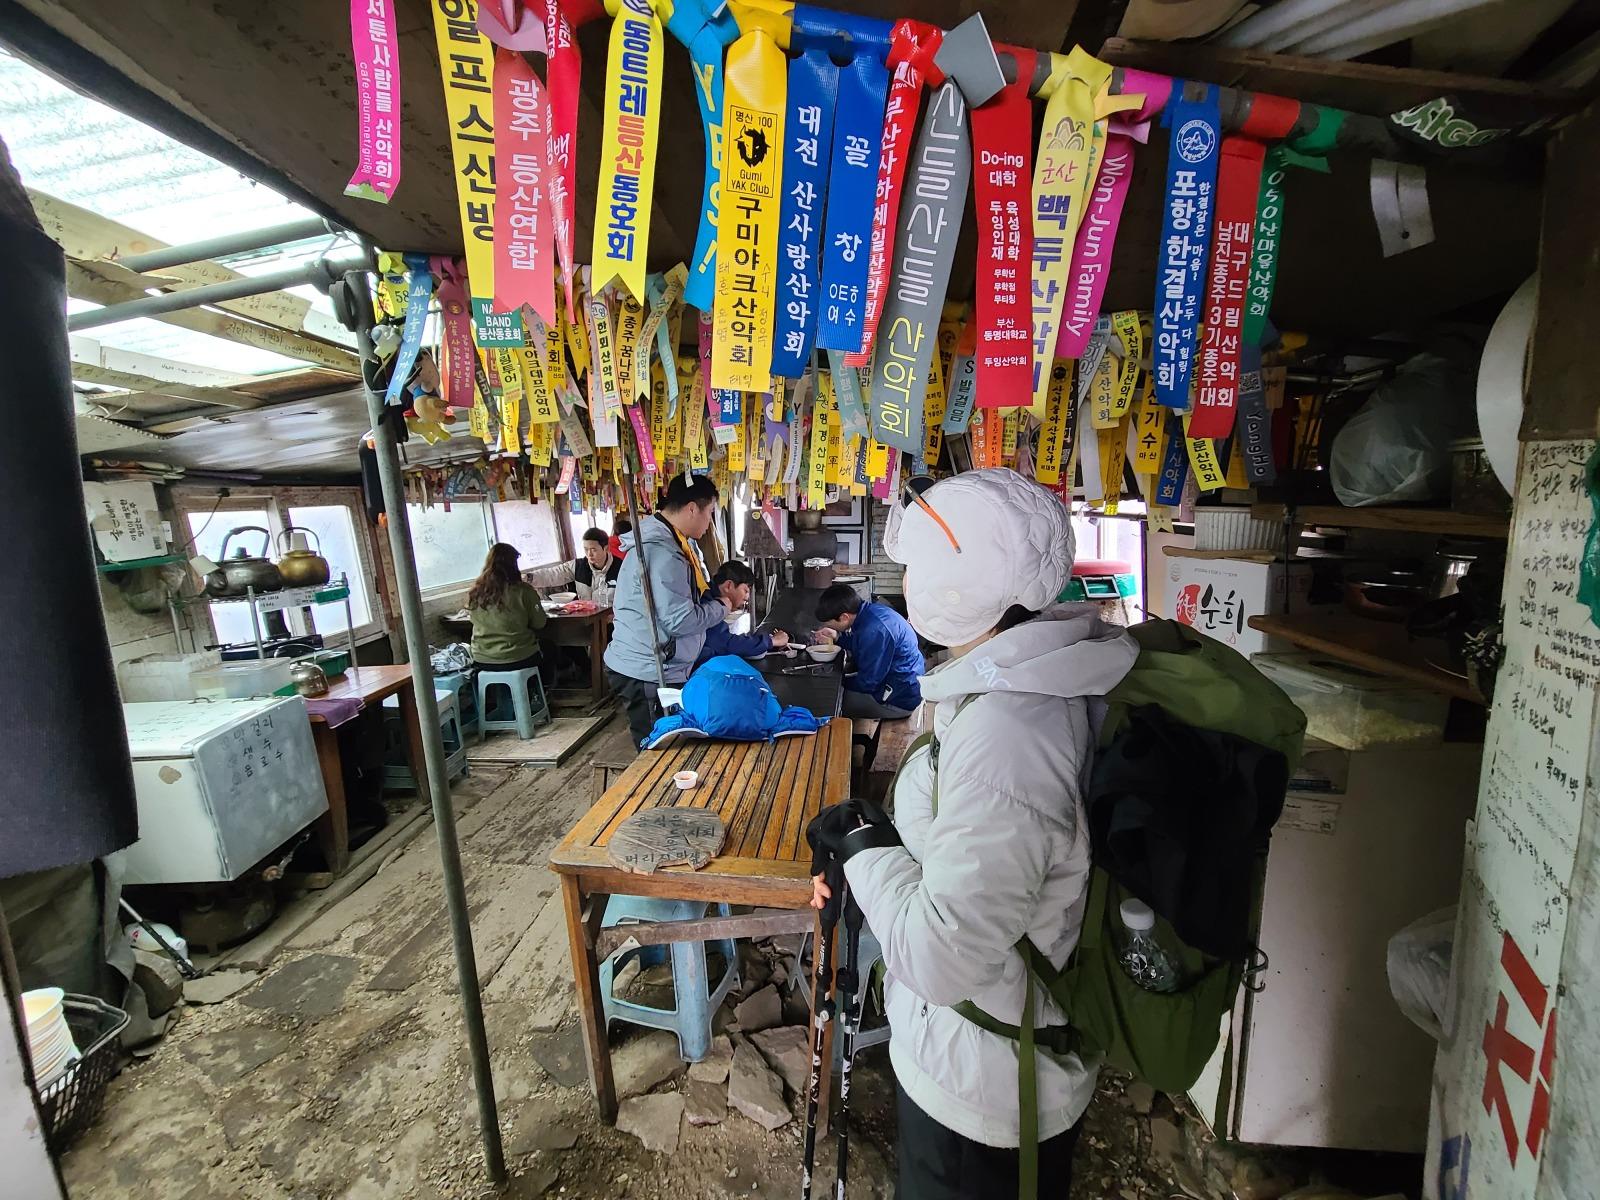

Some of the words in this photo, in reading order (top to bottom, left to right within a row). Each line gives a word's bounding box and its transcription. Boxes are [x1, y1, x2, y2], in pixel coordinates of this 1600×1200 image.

[508, 78, 542, 141] 광주
[735, 110, 754, 125] 명산
[757, 113, 773, 128] 100
[794, 104, 823, 167] 대전
[374, 118, 393, 179] 산악회
[980, 150, 1025, 168] Do-ing
[739, 168, 763, 183] Gumi
[989, 170, 1017, 188] 대학
[1041, 156, 1079, 185] 군산
[730, 179, 748, 192] YAK
[749, 181, 770, 195] Club
[508, 153, 543, 271] 등산연합
[1084, 153, 1128, 258] Won-Jun
[783, 180, 818, 359] 산사랑산악회
[728, 197, 763, 367] 구미야크산악회
[1065, 262, 1102, 338] Family
[485, 316, 512, 328] BAND
[996, 317, 1015, 329] 부산
[478, 327, 522, 341] 등산동호회
[982, 329, 1028, 342] 동명대학교
[983, 355, 1028, 368] 두잉산악회
[879, 316, 927, 438] 산악회
